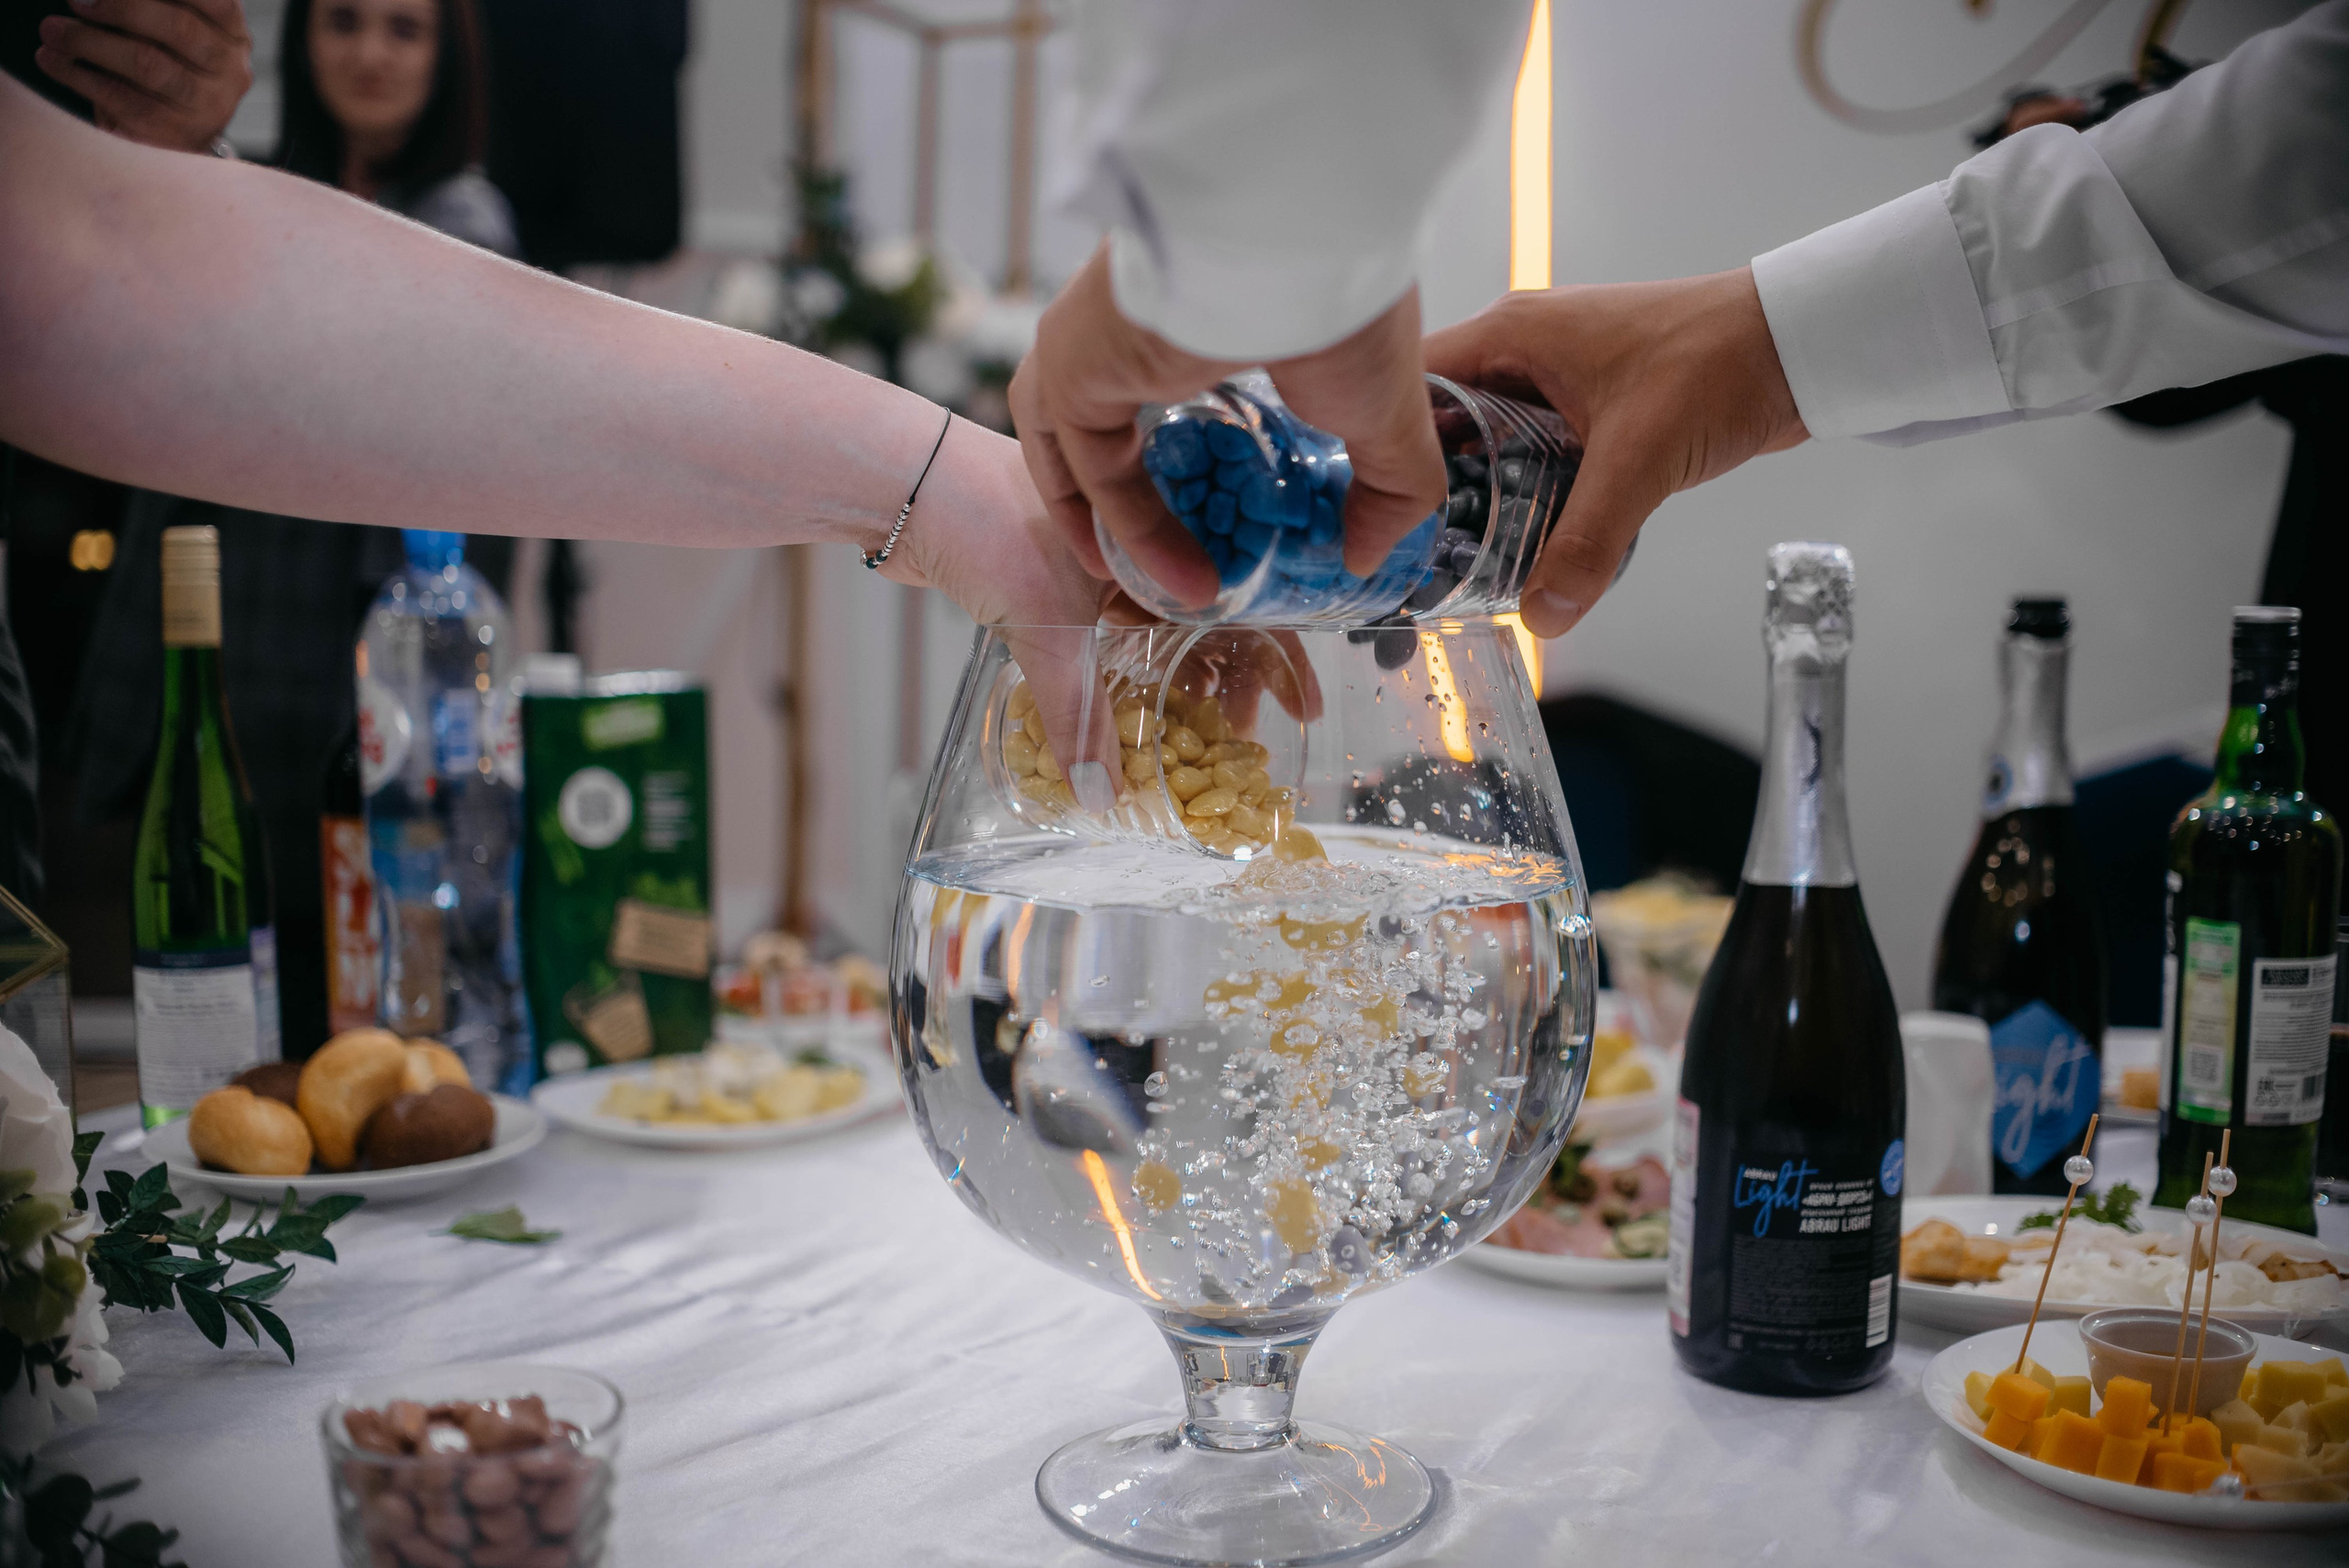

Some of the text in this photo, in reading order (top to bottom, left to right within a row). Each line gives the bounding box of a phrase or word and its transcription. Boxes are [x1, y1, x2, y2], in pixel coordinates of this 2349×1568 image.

[1994, 1034, 2091, 1164] ight
[1734, 1159, 1819, 1238] Light
[1799, 1215, 1872, 1233] ABRAU LIGHT
